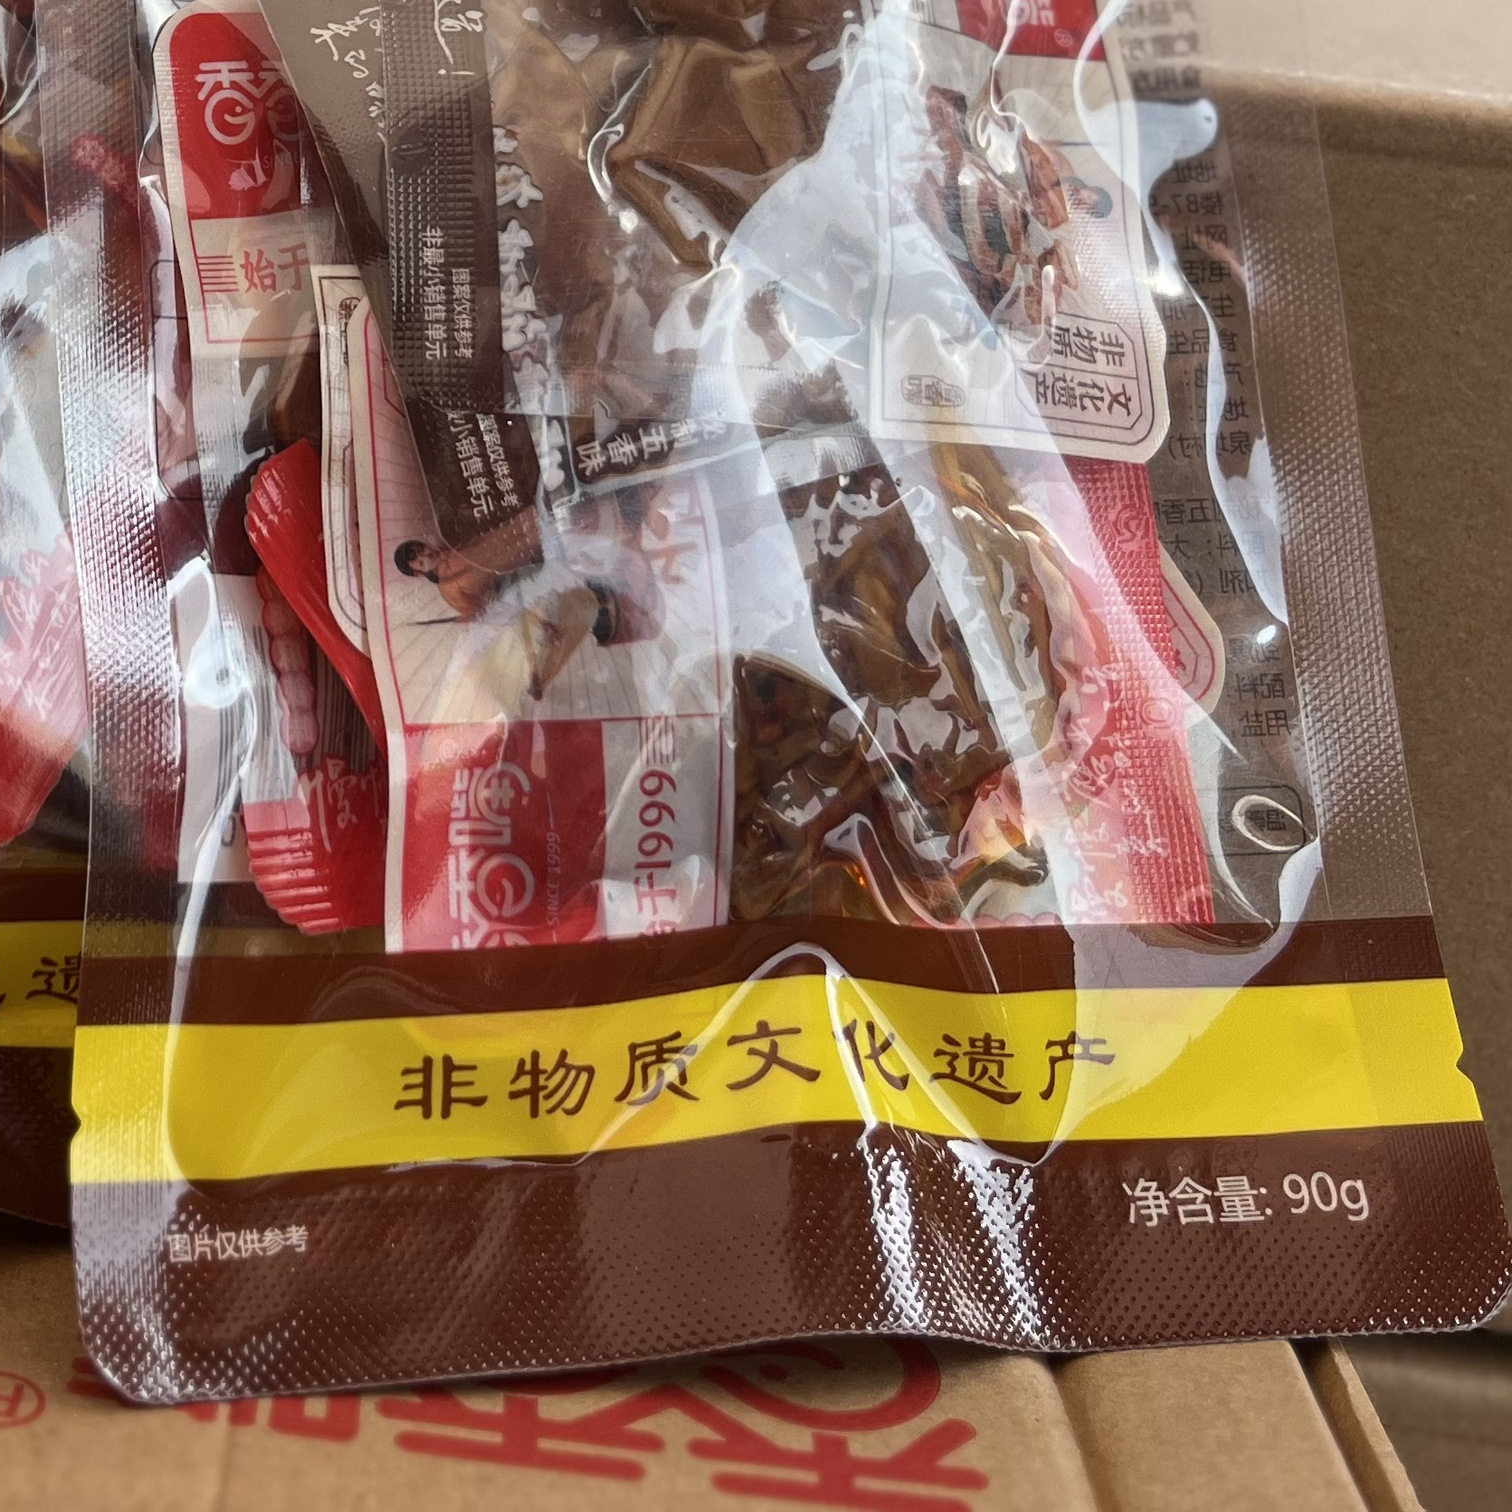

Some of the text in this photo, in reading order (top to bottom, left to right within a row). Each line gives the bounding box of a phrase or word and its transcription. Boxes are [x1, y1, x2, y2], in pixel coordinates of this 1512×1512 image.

[1018, 367, 1135, 418] 文化遗产
[545, 831, 562, 927] SINCE 1999
[393, 1018, 1117, 1121] 非物质文化遗产
[1122, 1170, 1371, 1228] 净含量: 90g
[167, 1223, 310, 1264] 图片仅供参考
